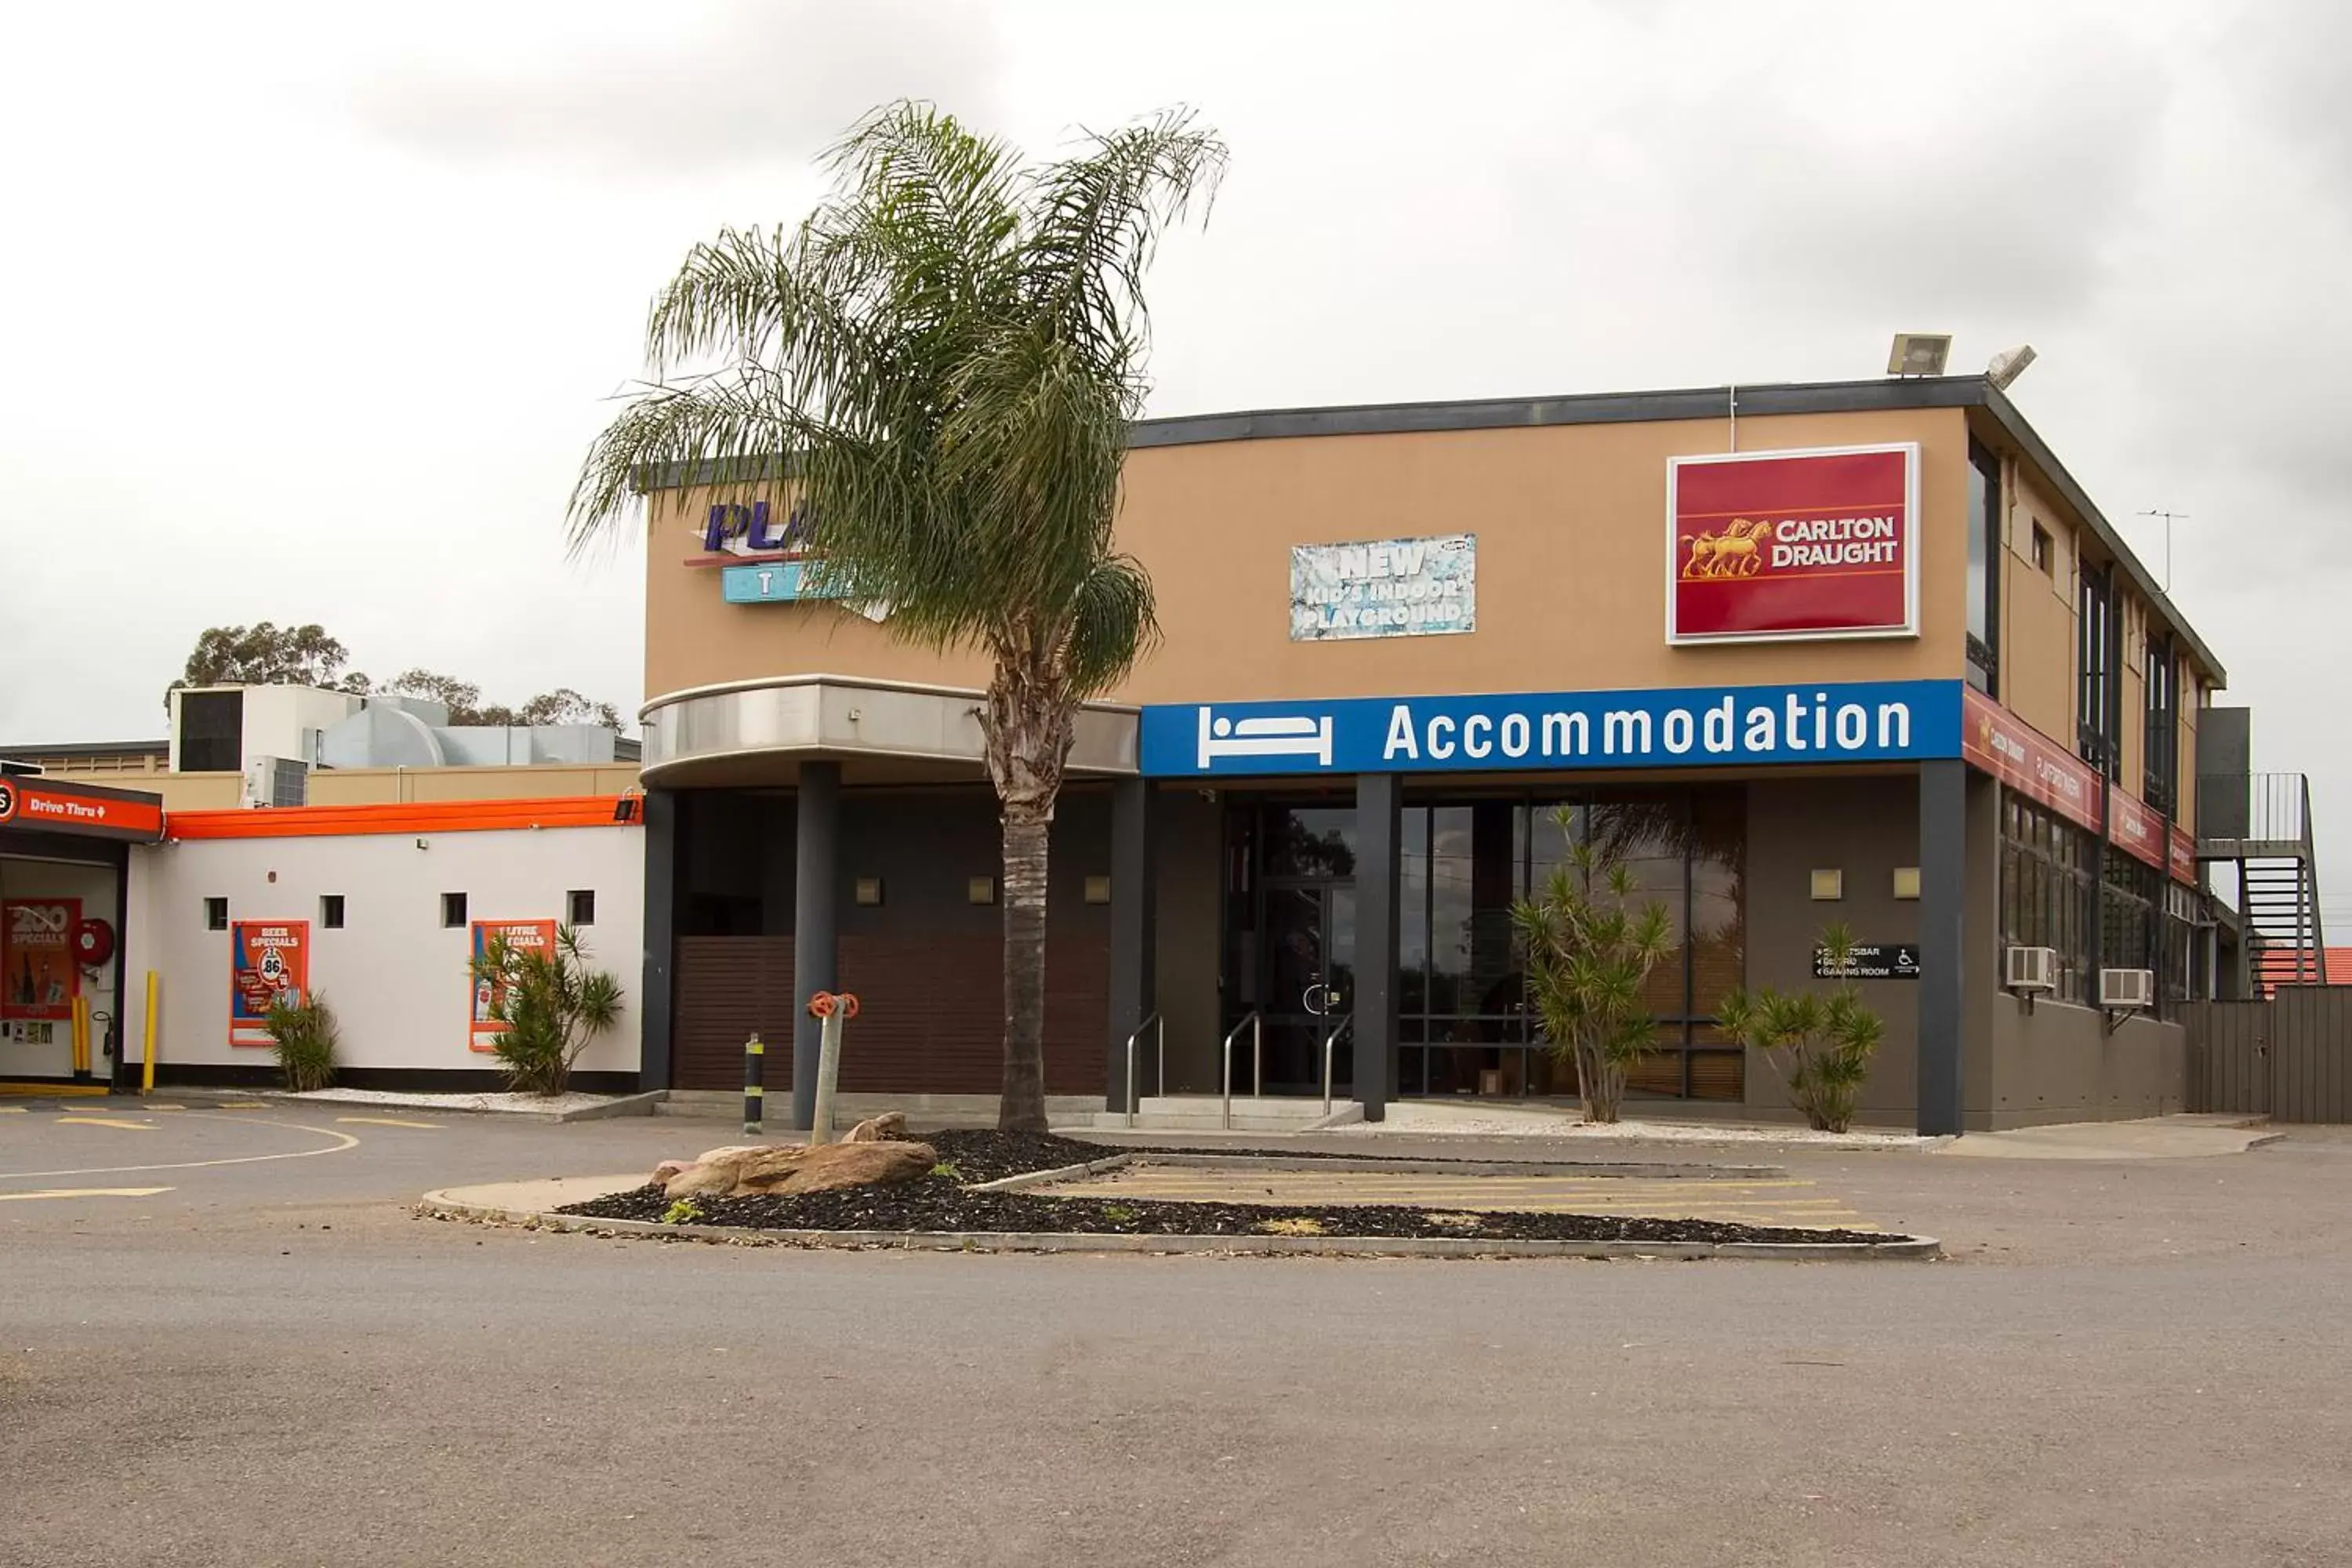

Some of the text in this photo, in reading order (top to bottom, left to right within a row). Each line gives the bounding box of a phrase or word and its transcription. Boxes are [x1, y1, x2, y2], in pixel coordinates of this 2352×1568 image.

[1775, 517, 1894, 543] CARLTON
[1338, 546, 1425, 579] NEW
[1771, 541, 1898, 567] DRAUGHT
[1370, 579, 1461, 601] INDOOR
[1301, 603, 1463, 628] PLAYGROUND
[1382, 692, 1911, 760] Accommodation
[31, 798, 95, 817] Drive Thru
[12, 932, 67, 945] SPECIALS
[250, 937, 299, 948] SPECIALS
[1860, 967, 1889, 976] ROOM
